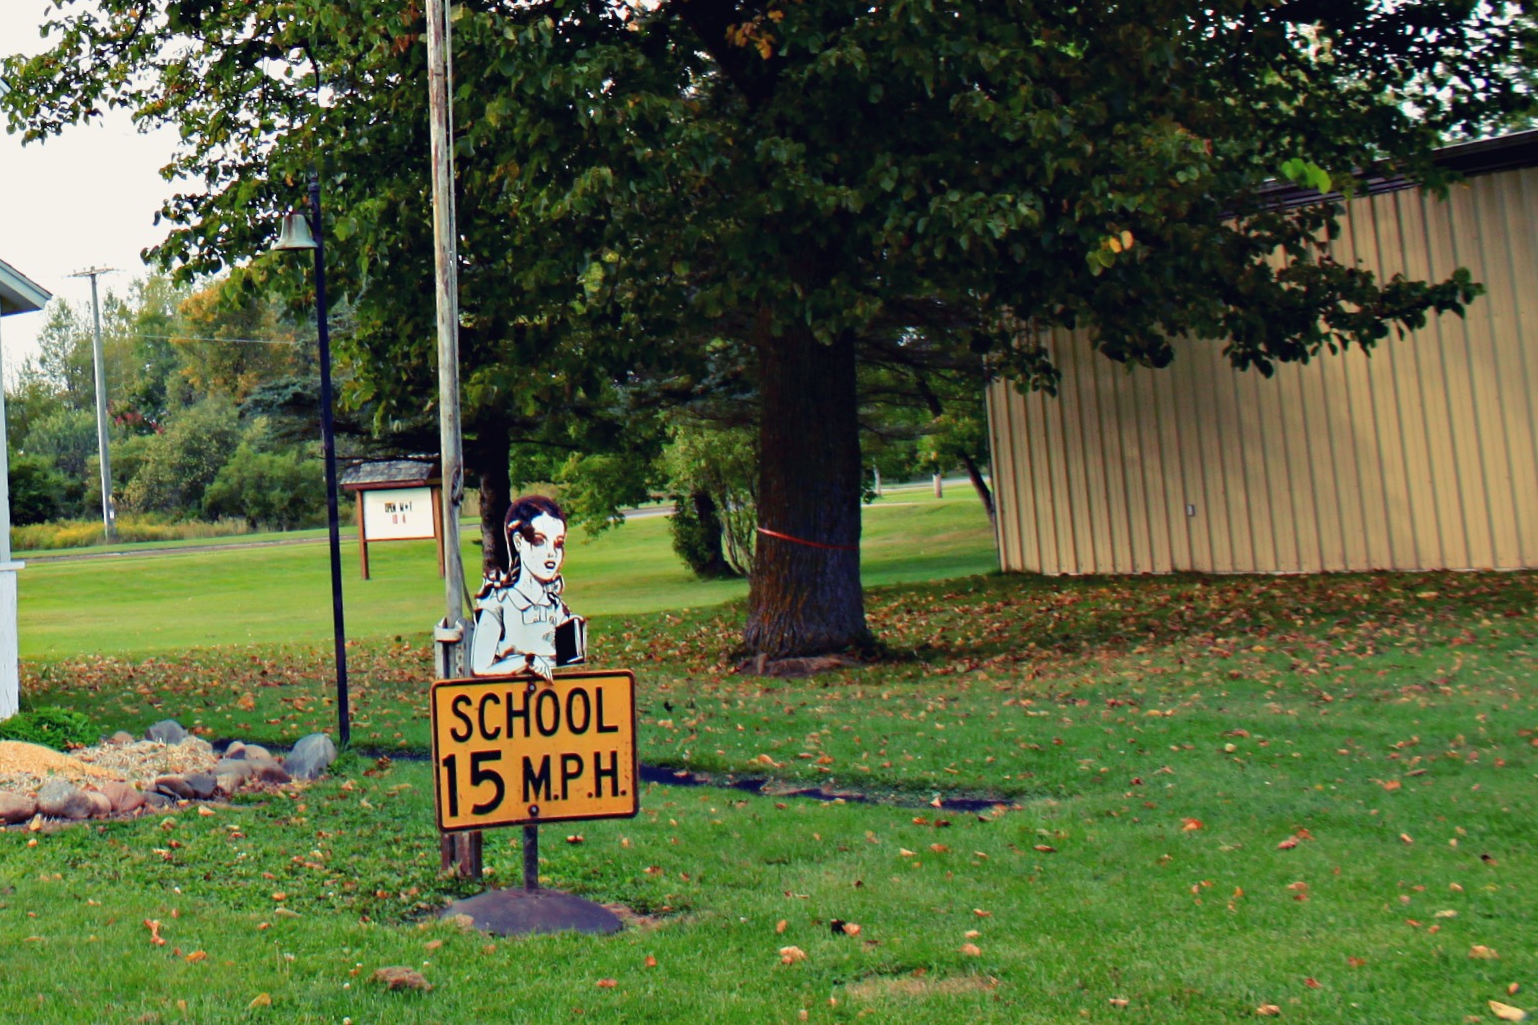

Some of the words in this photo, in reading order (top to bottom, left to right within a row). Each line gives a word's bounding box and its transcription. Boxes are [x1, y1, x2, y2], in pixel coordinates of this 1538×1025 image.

[449, 687, 619, 743] SCHOOL
[442, 749, 505, 817] 15
[522, 750, 627, 802] M.P.H.
